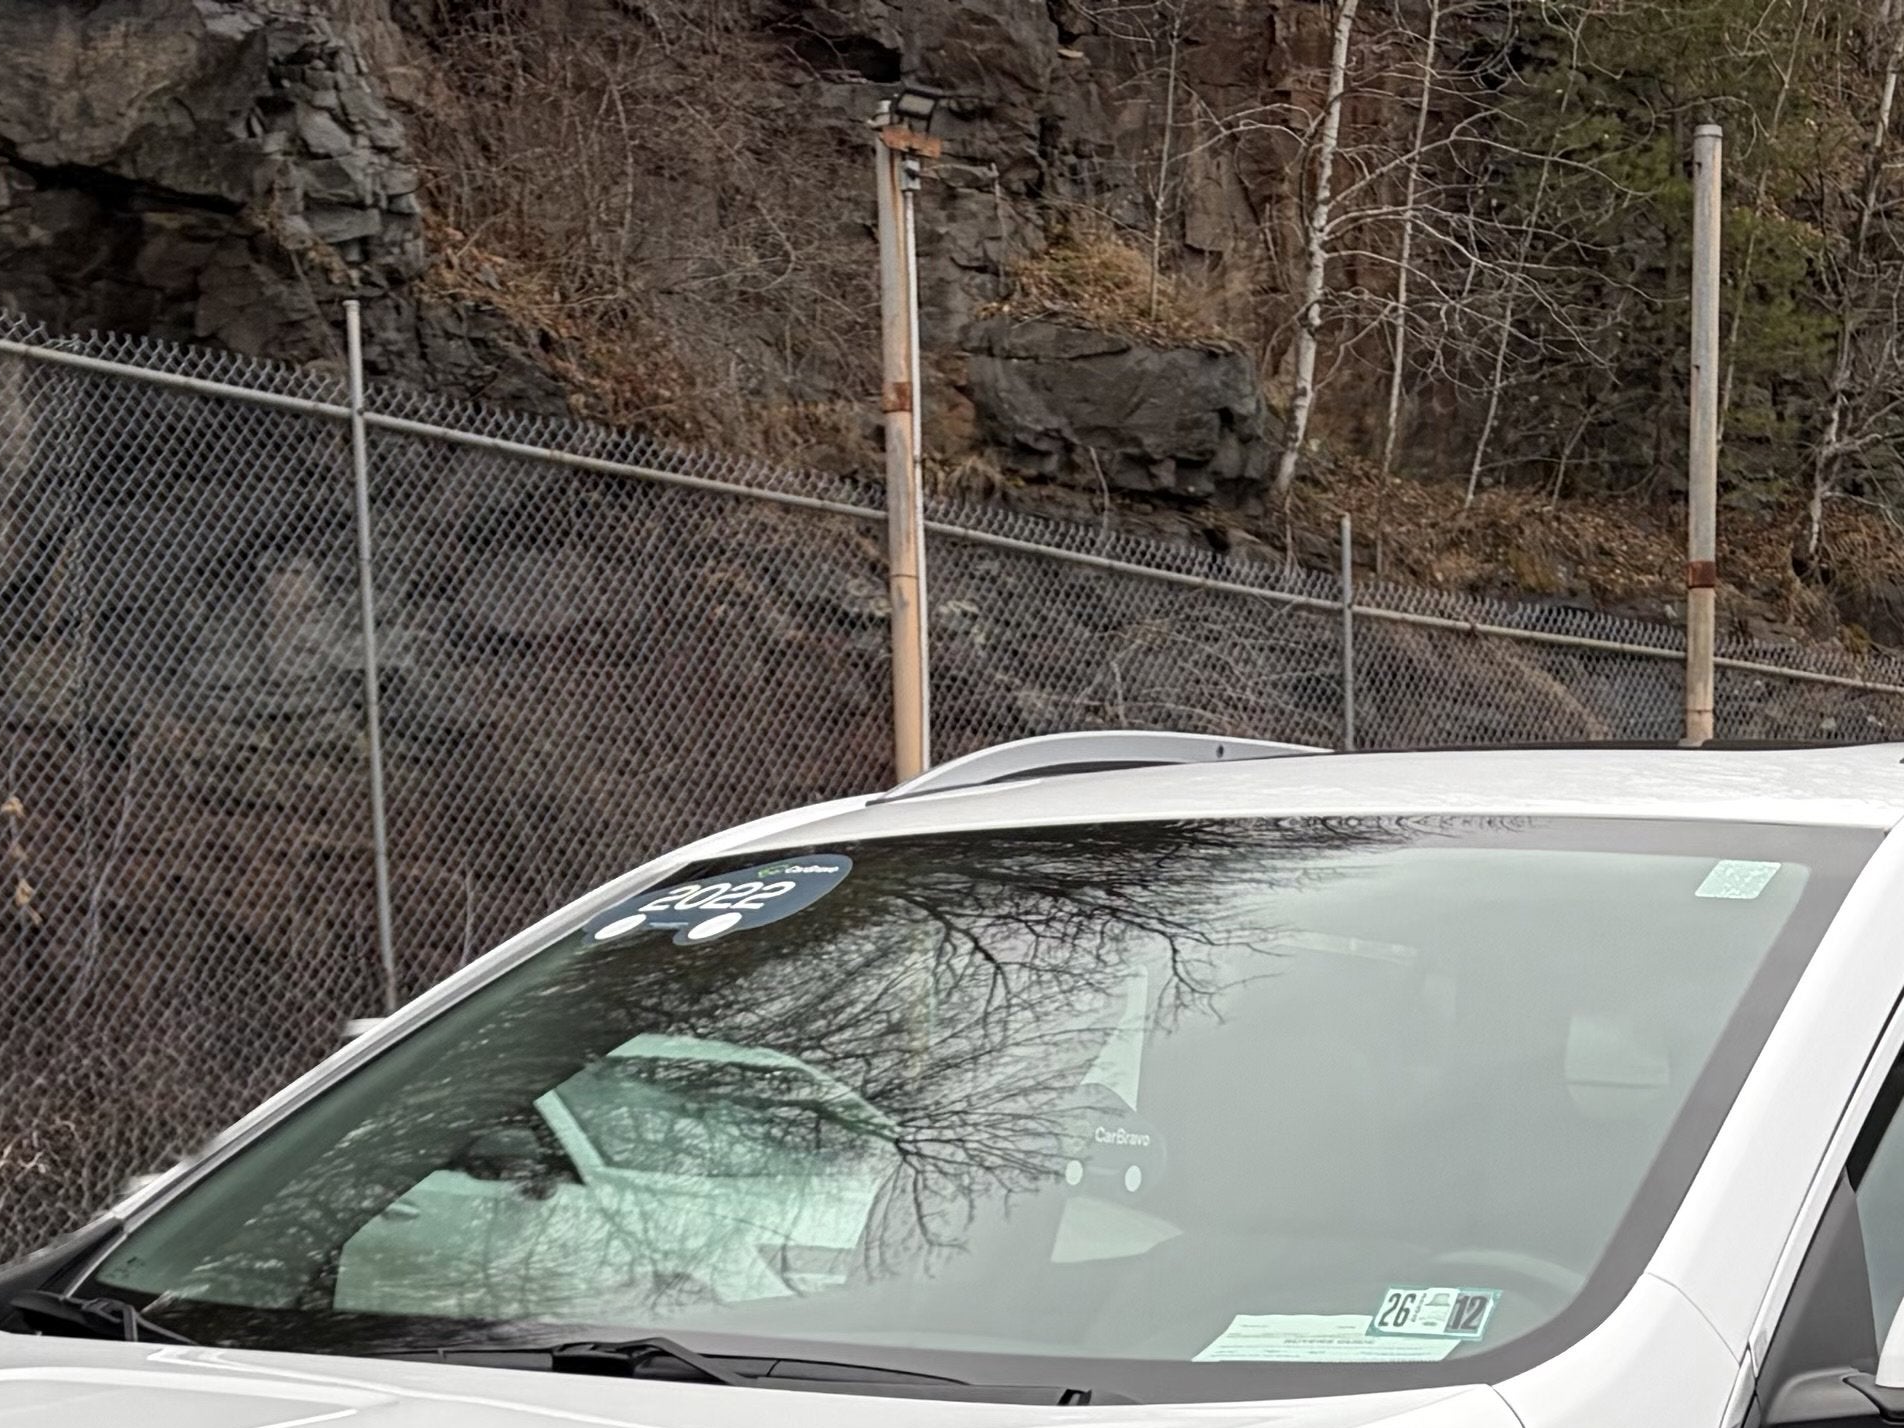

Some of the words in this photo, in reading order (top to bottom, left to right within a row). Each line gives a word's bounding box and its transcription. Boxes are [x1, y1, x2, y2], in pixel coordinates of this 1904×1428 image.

[638, 881, 795, 910] 2022
[1095, 1126, 1151, 1147] CarBravo
[1378, 1292, 1416, 1328] 26
[1449, 1295, 1489, 1330] 12
